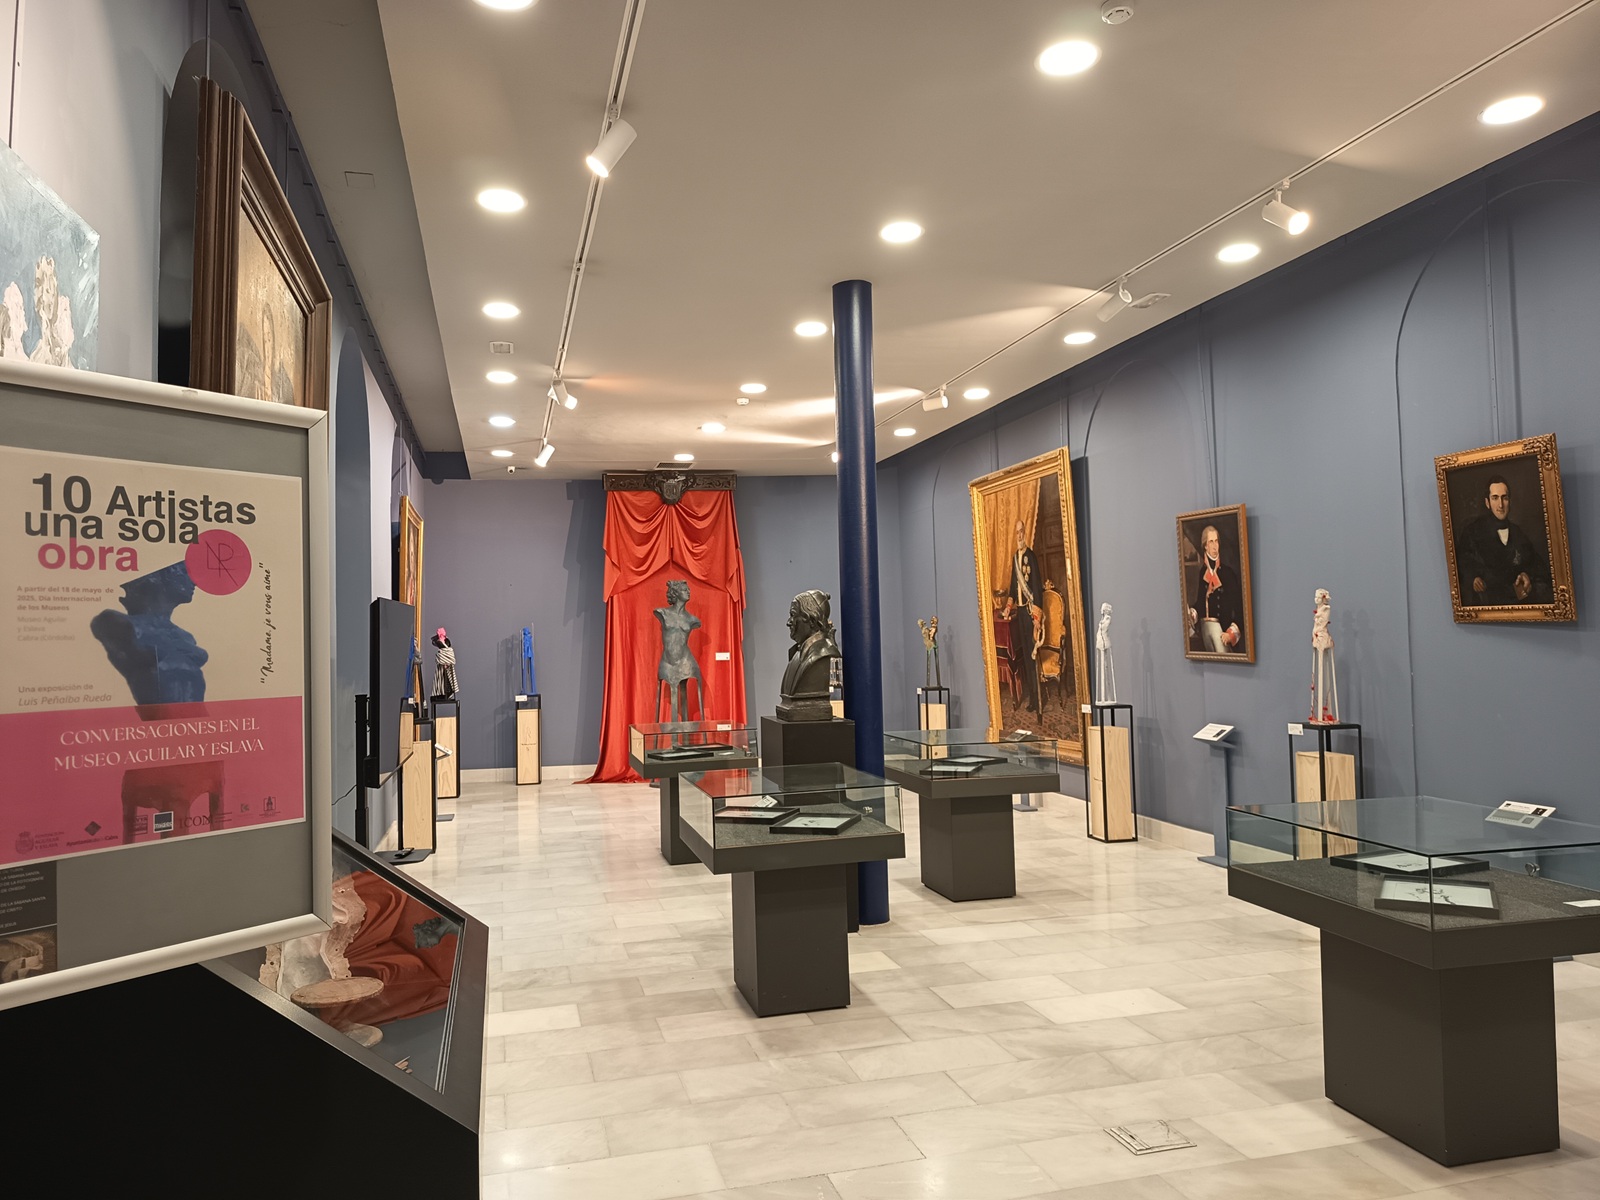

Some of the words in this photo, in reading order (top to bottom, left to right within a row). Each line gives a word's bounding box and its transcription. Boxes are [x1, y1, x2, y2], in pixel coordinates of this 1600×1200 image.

[32, 473, 92, 514] 10
[105, 485, 257, 525] Artistas
[25, 511, 104, 539] una
[118, 506, 200, 544] sola
[38, 537, 139, 572] obra
[18, 698, 38, 706] Luis
[41, 695, 80, 705] Peñalba
[82, 694, 112, 702] Rueda
[38, 684, 82, 693] exposición
[60, 720, 216, 746] CONVERSACIONES
[219, 718, 239, 732] EN
[242, 718, 260, 731] EL
[54, 751, 121, 771] MUSEO
[123, 744, 196, 765] AGUILAR
[198, 744, 209, 757] Y
[211, 738, 265, 756] ESLAVA
